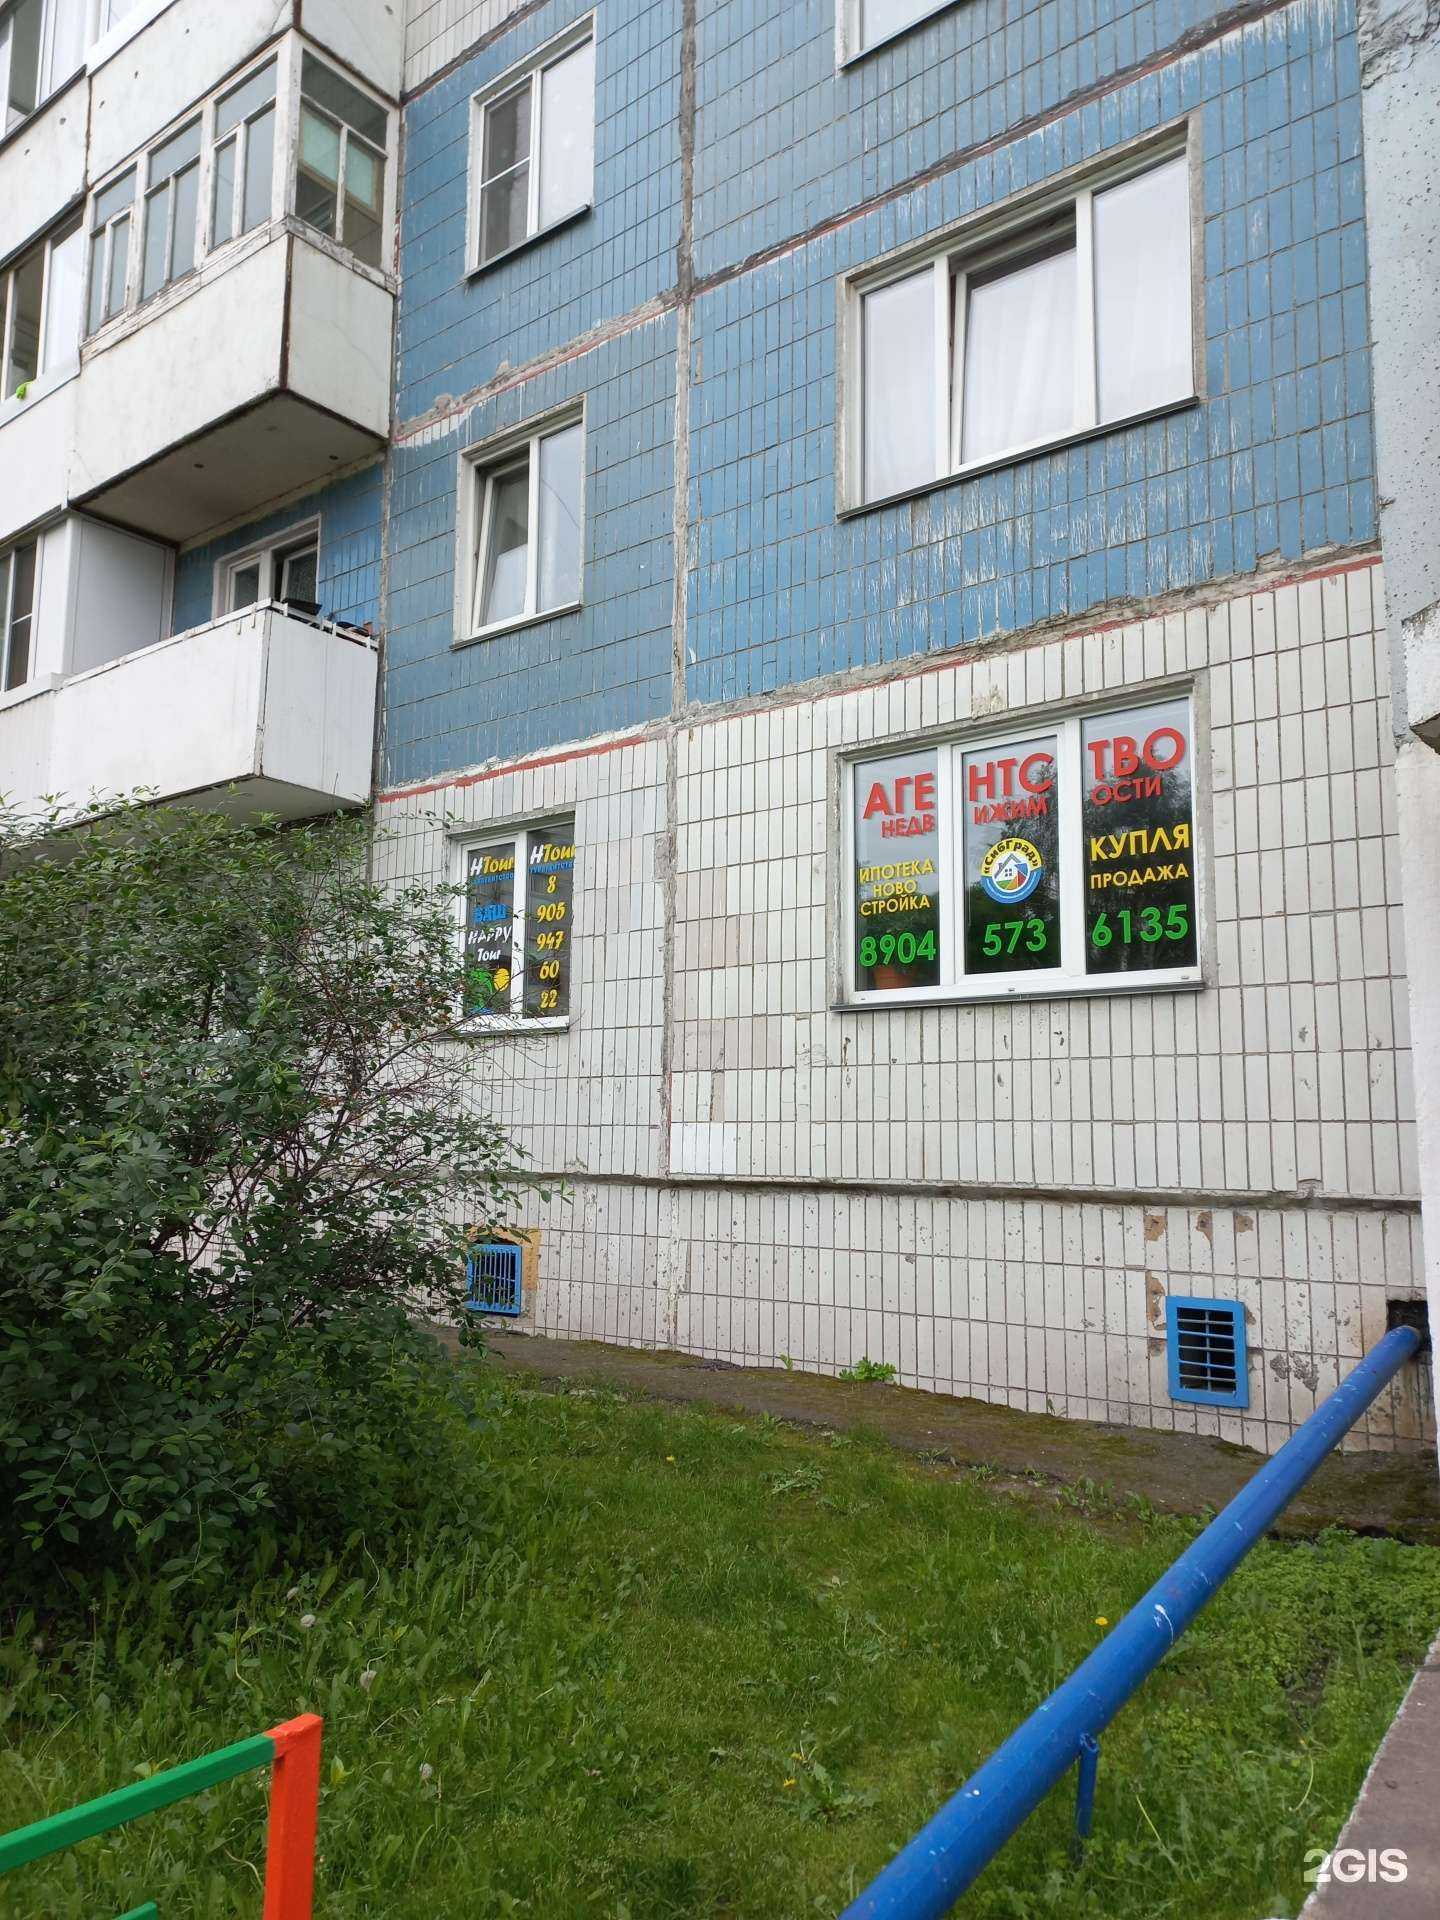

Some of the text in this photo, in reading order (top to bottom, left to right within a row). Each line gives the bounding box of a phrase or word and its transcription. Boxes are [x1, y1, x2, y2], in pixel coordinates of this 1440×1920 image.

[862, 727, 1186, 820] АГЕ НТС ТВО
[881, 775, 1162, 838] НЕДВ ИЖИМ ОСТИ
[1090, 823, 1191, 862] КУПЛЯ
[858, 857, 934, 883] ИПОТЕКА
[1090, 863, 1190, 890] ПРОДАЖА
[546, 876, 557, 895] 8
[872, 879, 917, 898] НОВО
[537, 901, 566, 923] 905
[859, 896, 931, 918] СТРОЙКА
[536, 931, 565, 952] 947
[859, 904, 1190, 967] 8904 573 6135
[539, 959, 560, 981] 60
[540, 989, 558, 1009] 22
